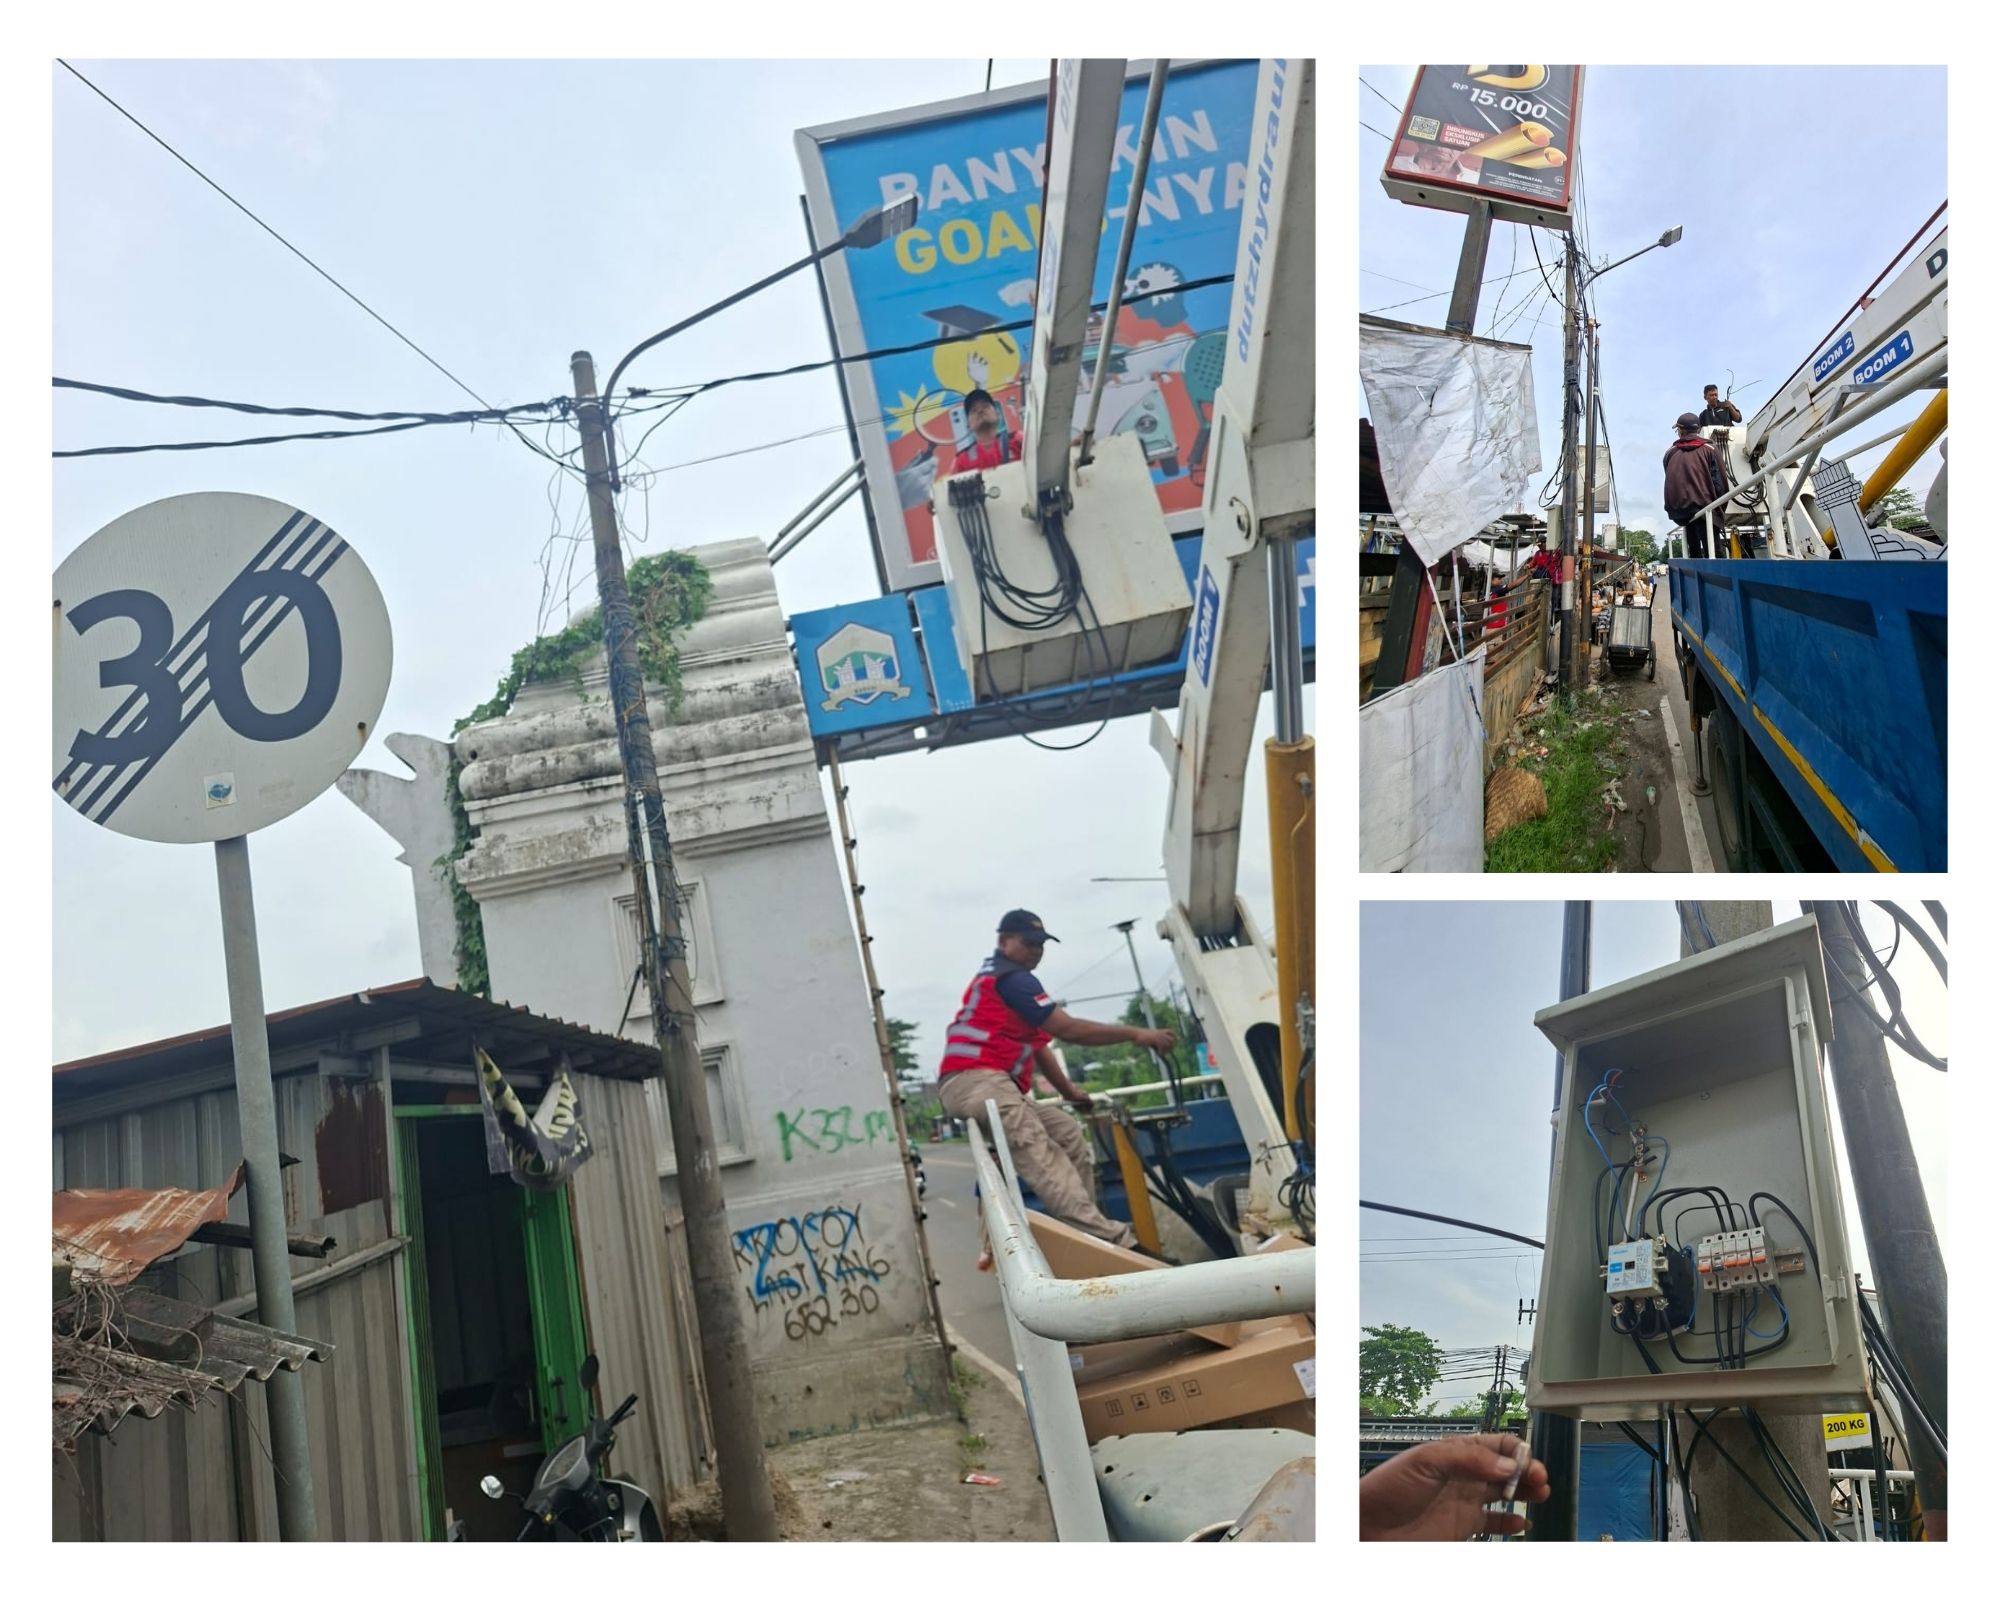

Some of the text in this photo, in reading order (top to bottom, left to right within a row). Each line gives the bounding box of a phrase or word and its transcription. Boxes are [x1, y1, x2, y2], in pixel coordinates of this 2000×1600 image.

[1452, 82, 1547, 119] RP 15.000
[878, 110, 1218, 211] BANYKIN
[1444, 136, 1471, 147] SATUAN
[895, 162, 1249, 275] GOA-NYA
[1814, 336, 1854, 377] BOOM 2
[1855, 337, 1910, 385] BOOM 1
[1195, 595, 1215, 679] BOOM
[66, 568, 343, 766] 30
[1827, 1418, 1865, 1433] 200 KG
